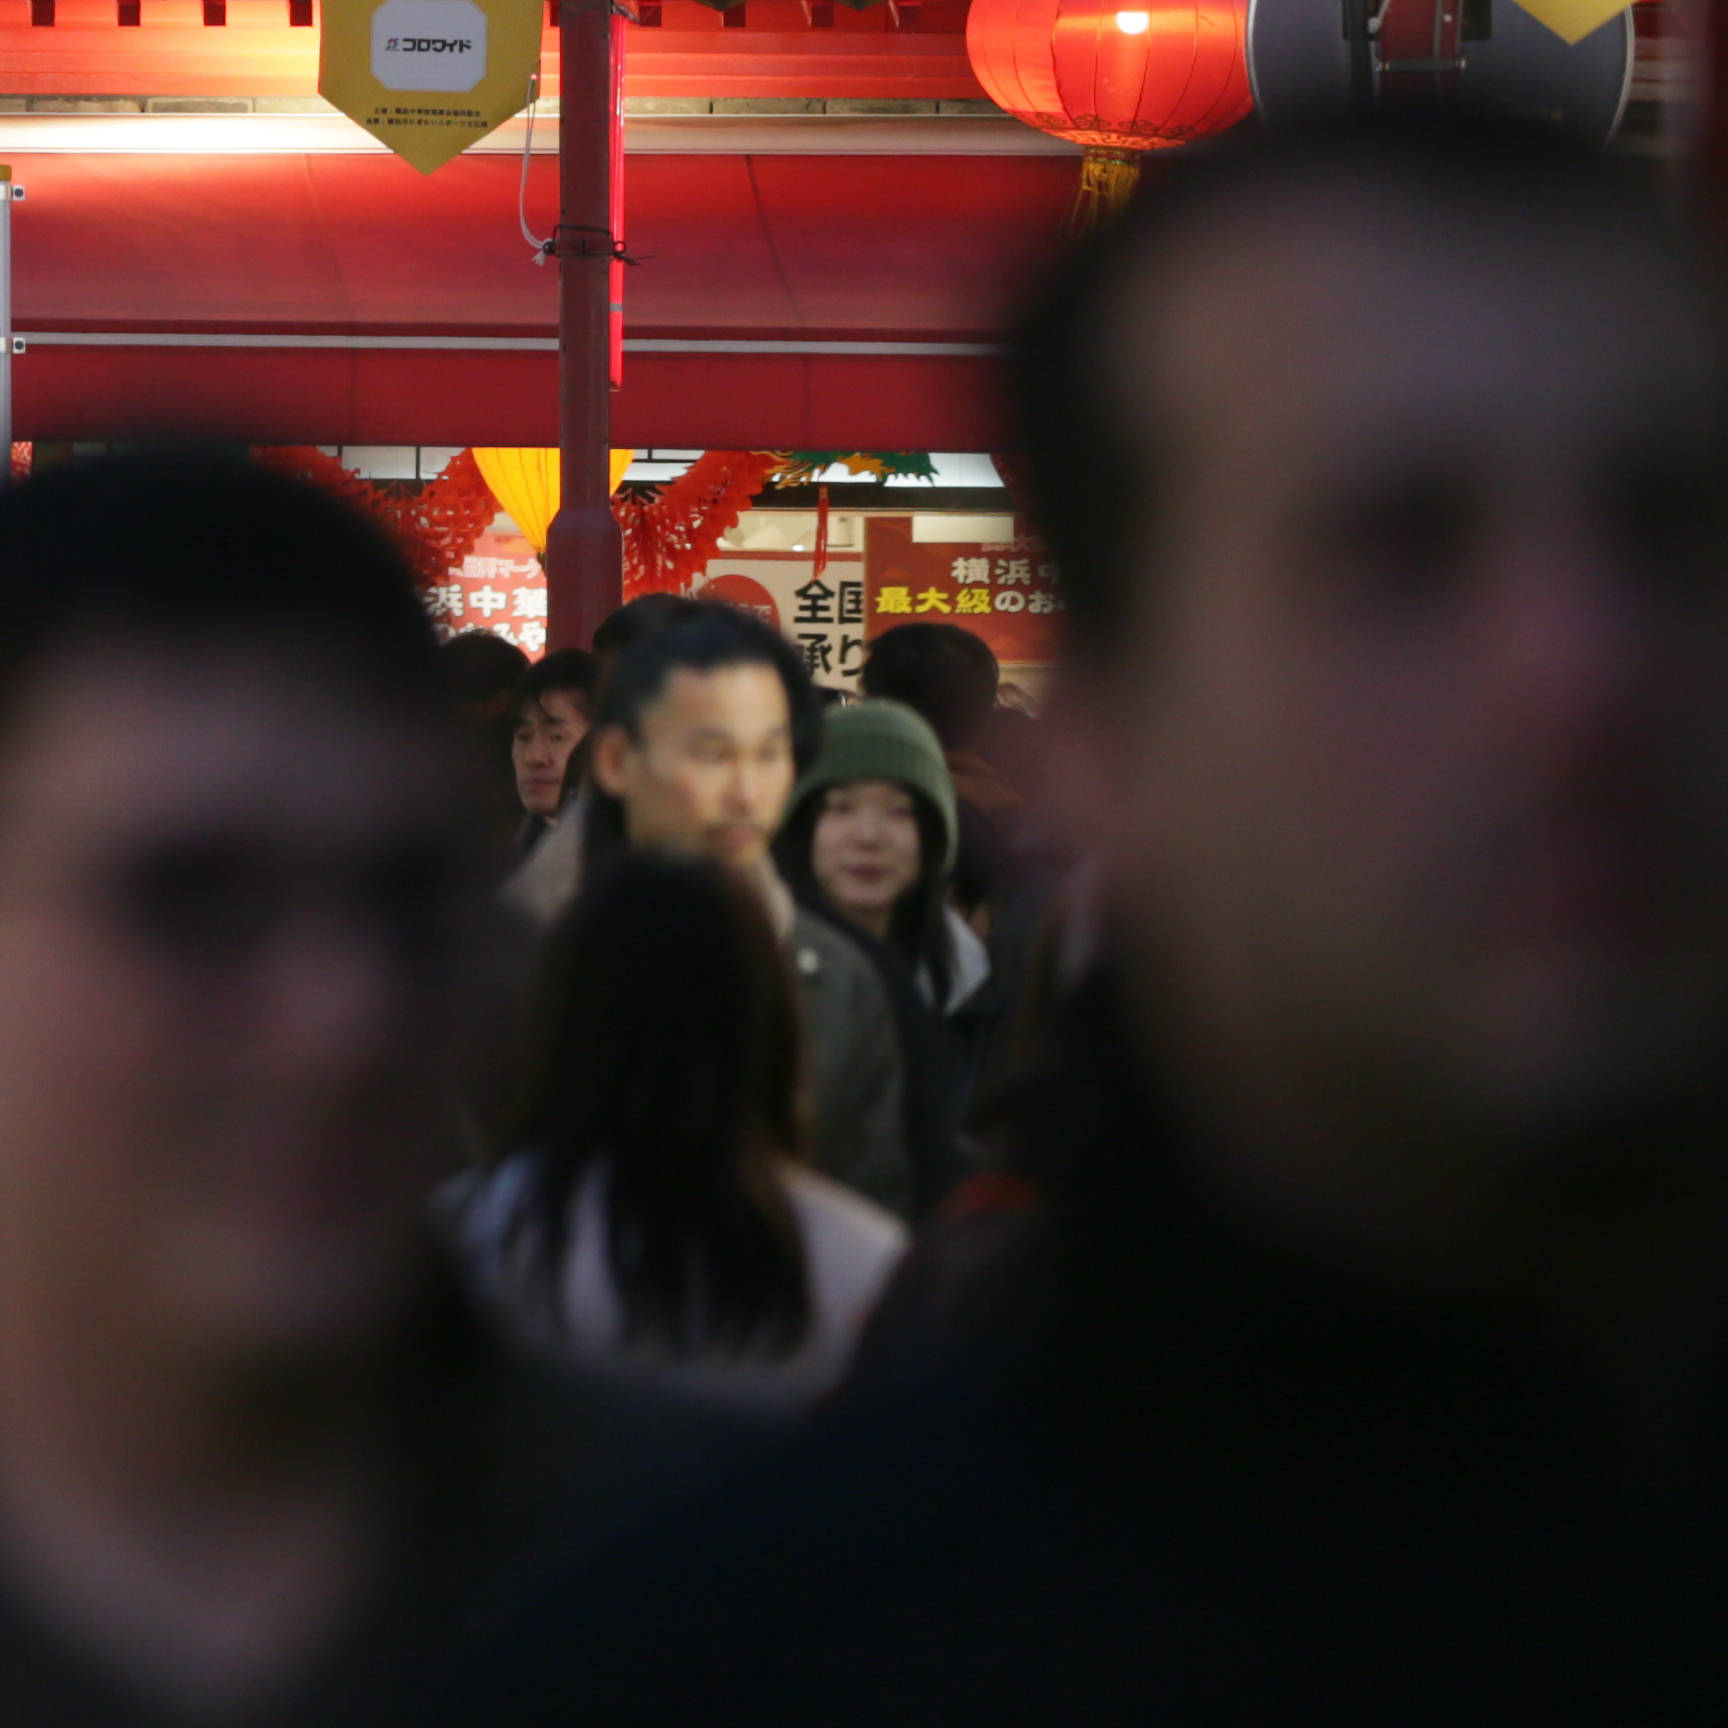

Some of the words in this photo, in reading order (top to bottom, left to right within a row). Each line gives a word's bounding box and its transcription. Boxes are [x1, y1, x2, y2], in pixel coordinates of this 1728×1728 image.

[401, 38, 472, 53] コロワイド
